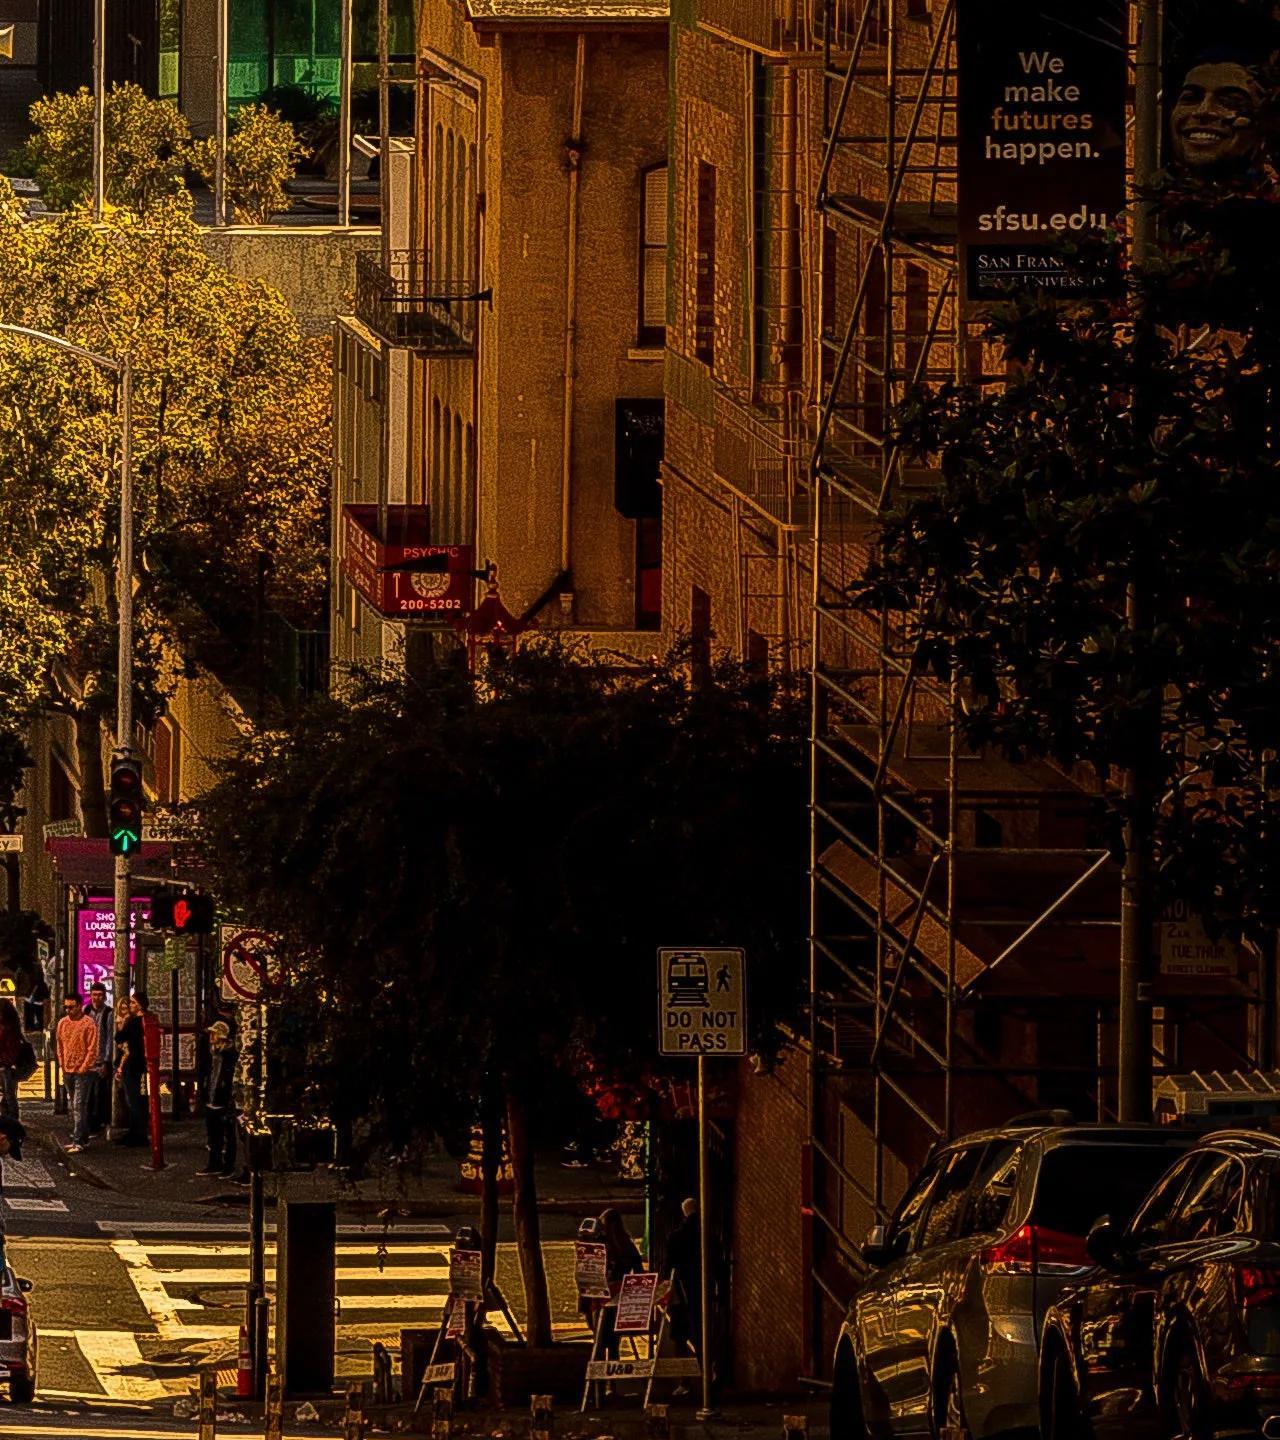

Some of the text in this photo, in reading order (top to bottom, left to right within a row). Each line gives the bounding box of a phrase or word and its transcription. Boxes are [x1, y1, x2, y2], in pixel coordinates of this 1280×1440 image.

[1017, 51, 1065, 75] We
[1004, 78, 1081, 102] make
[991, 106, 1094, 131] futures
[985, 135, 1101, 165] happen.
[978, 204, 1108, 231] sfsu.edu
[978, 254, 1011, 269] SAN
[667, 1011, 737, 1028] DO NOT
[679, 1033, 727, 1049] PASS
